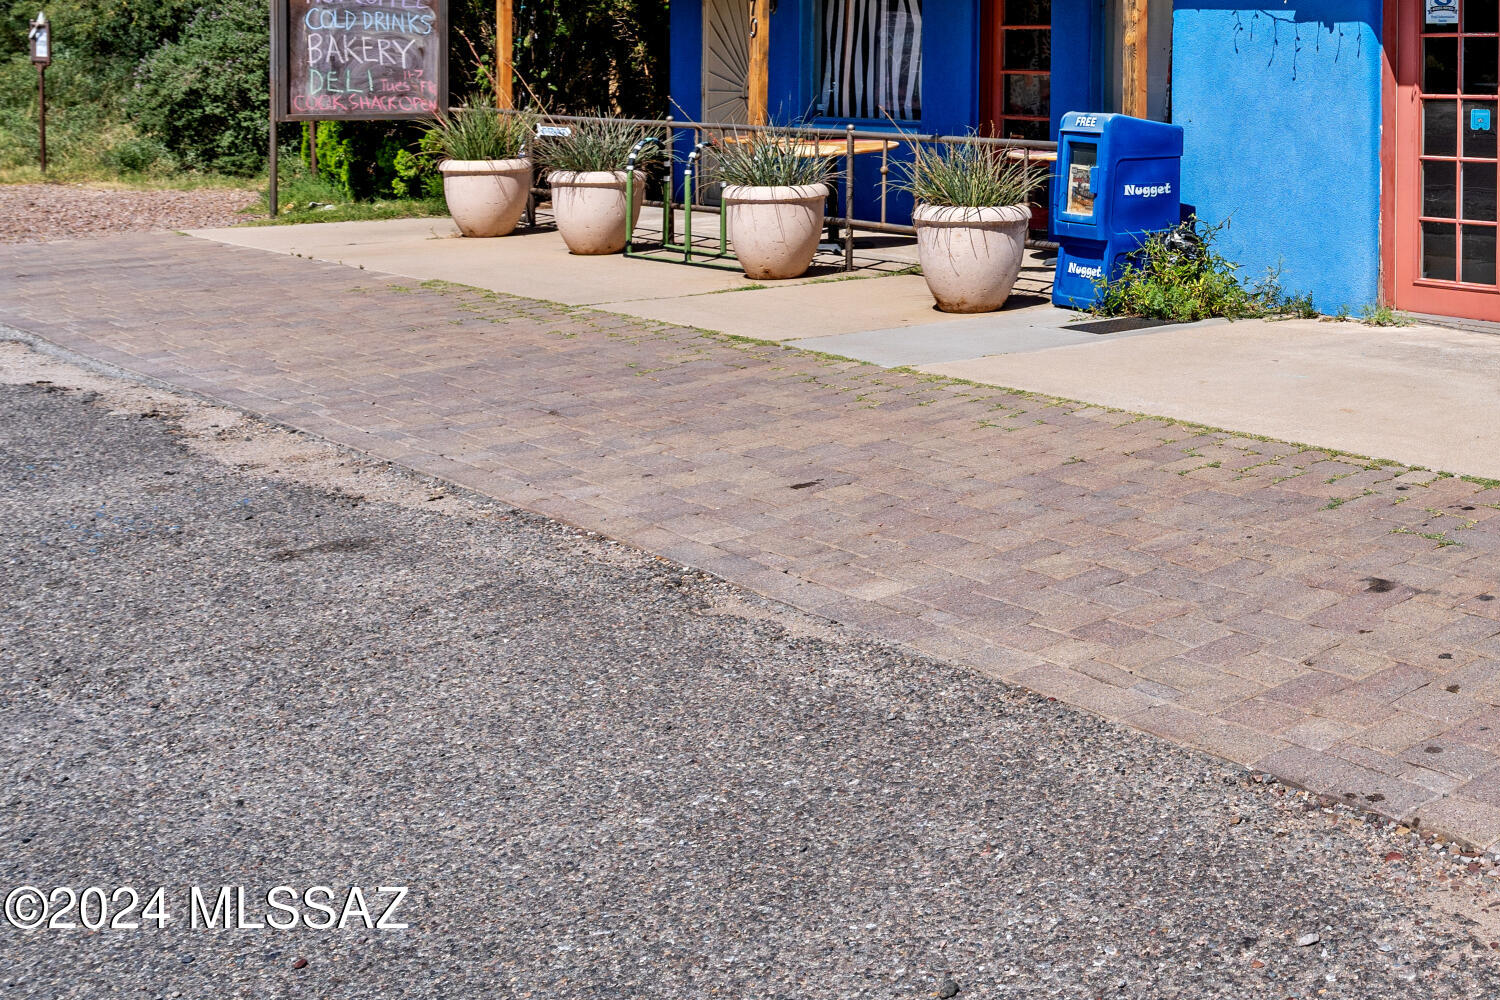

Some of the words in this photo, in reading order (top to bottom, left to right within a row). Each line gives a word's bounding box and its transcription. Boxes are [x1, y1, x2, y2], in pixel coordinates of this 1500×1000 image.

[305, 8, 356, 31] COLD
[362, 11, 434, 35] DRINKS
[307, 33, 416, 69] BAKERY
[309, 68, 374, 95] DELI
[294, 95, 347, 111] COOK
[350, 94, 398, 111] SHACK
[1075, 116, 1097, 127] FREE
[1124, 183, 1171, 198] Nugget
[1067, 262, 1102, 279] Nugget
